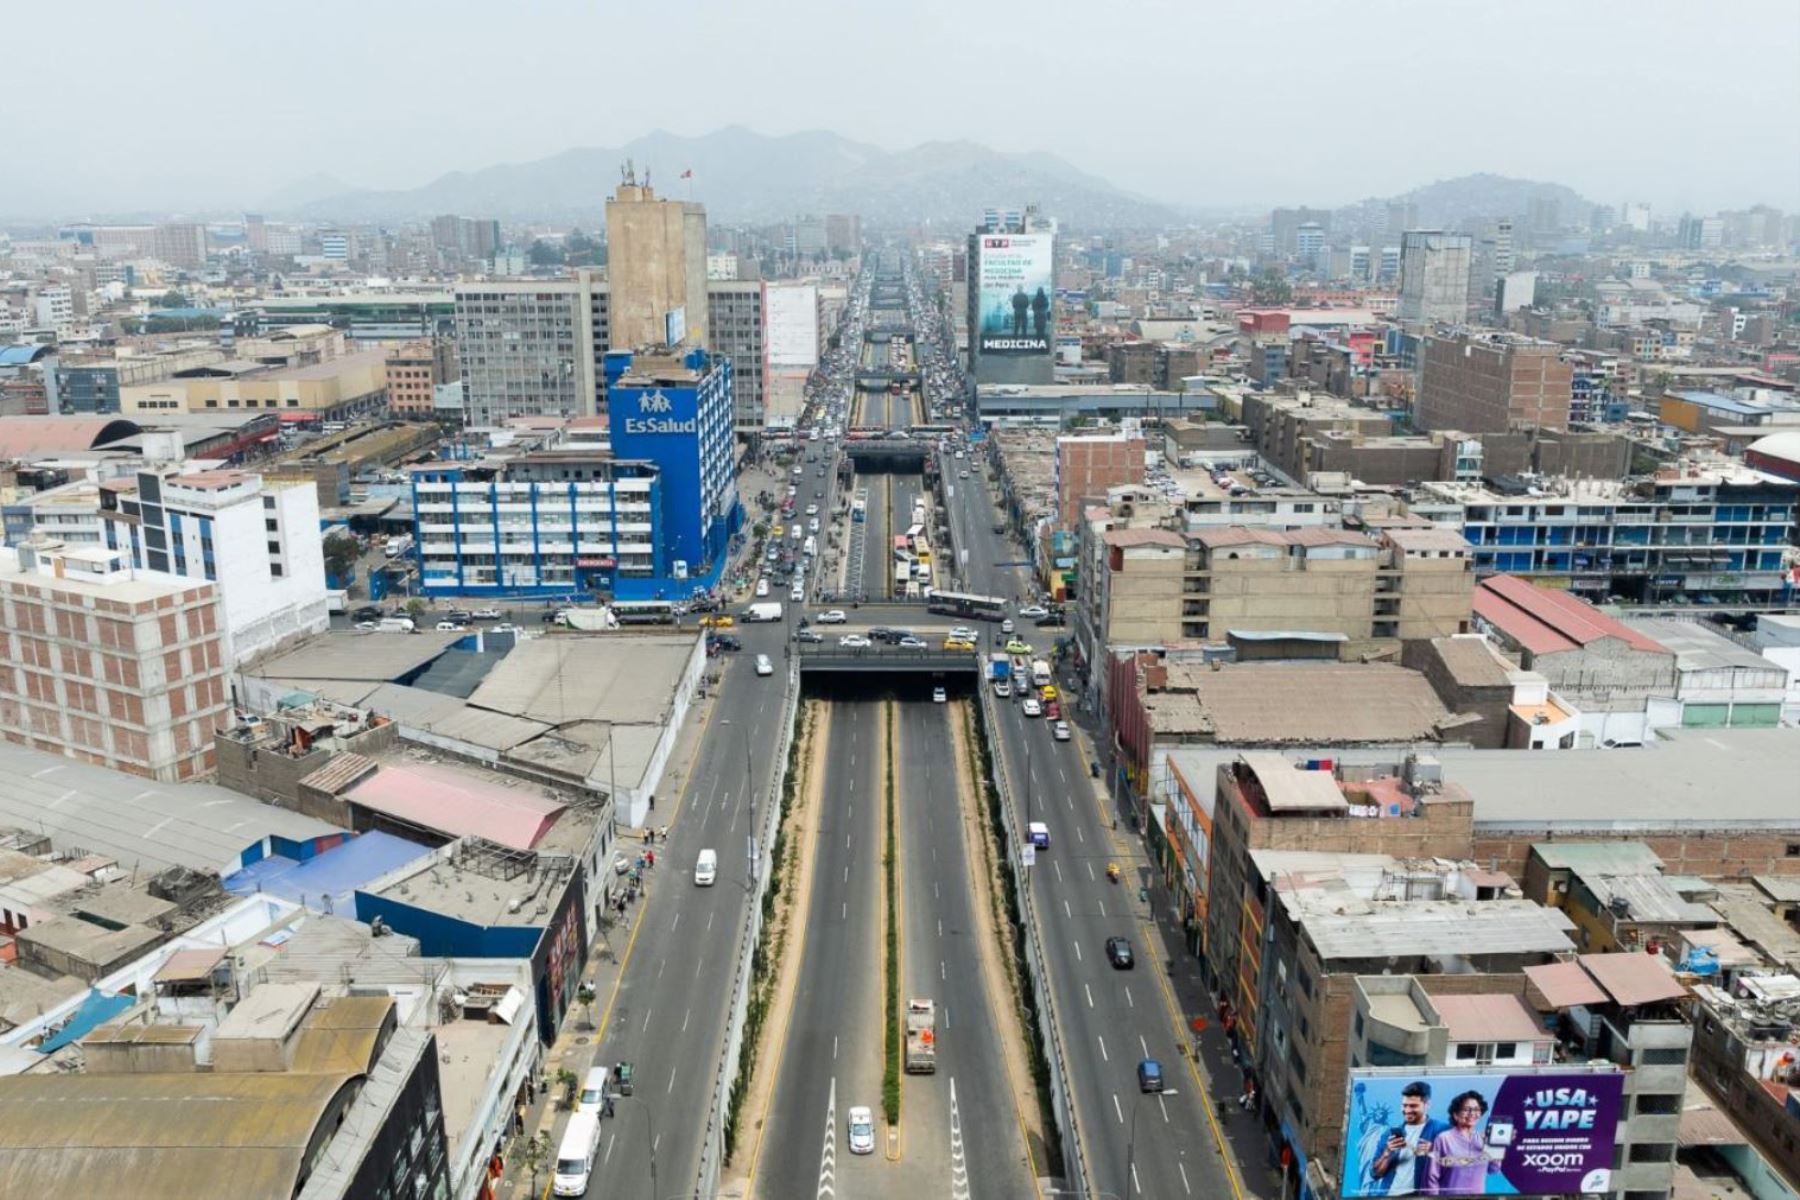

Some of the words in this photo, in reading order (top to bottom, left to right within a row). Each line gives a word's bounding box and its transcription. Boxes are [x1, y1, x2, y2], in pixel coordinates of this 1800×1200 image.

[984, 339, 1047, 349] MEDICINA
[625, 417, 696, 434] EsSalud
[1535, 1088, 1587, 1107] USA
[1524, 1110, 1597, 1129] YAPE
[1522, 1153, 1584, 1166] xoom
